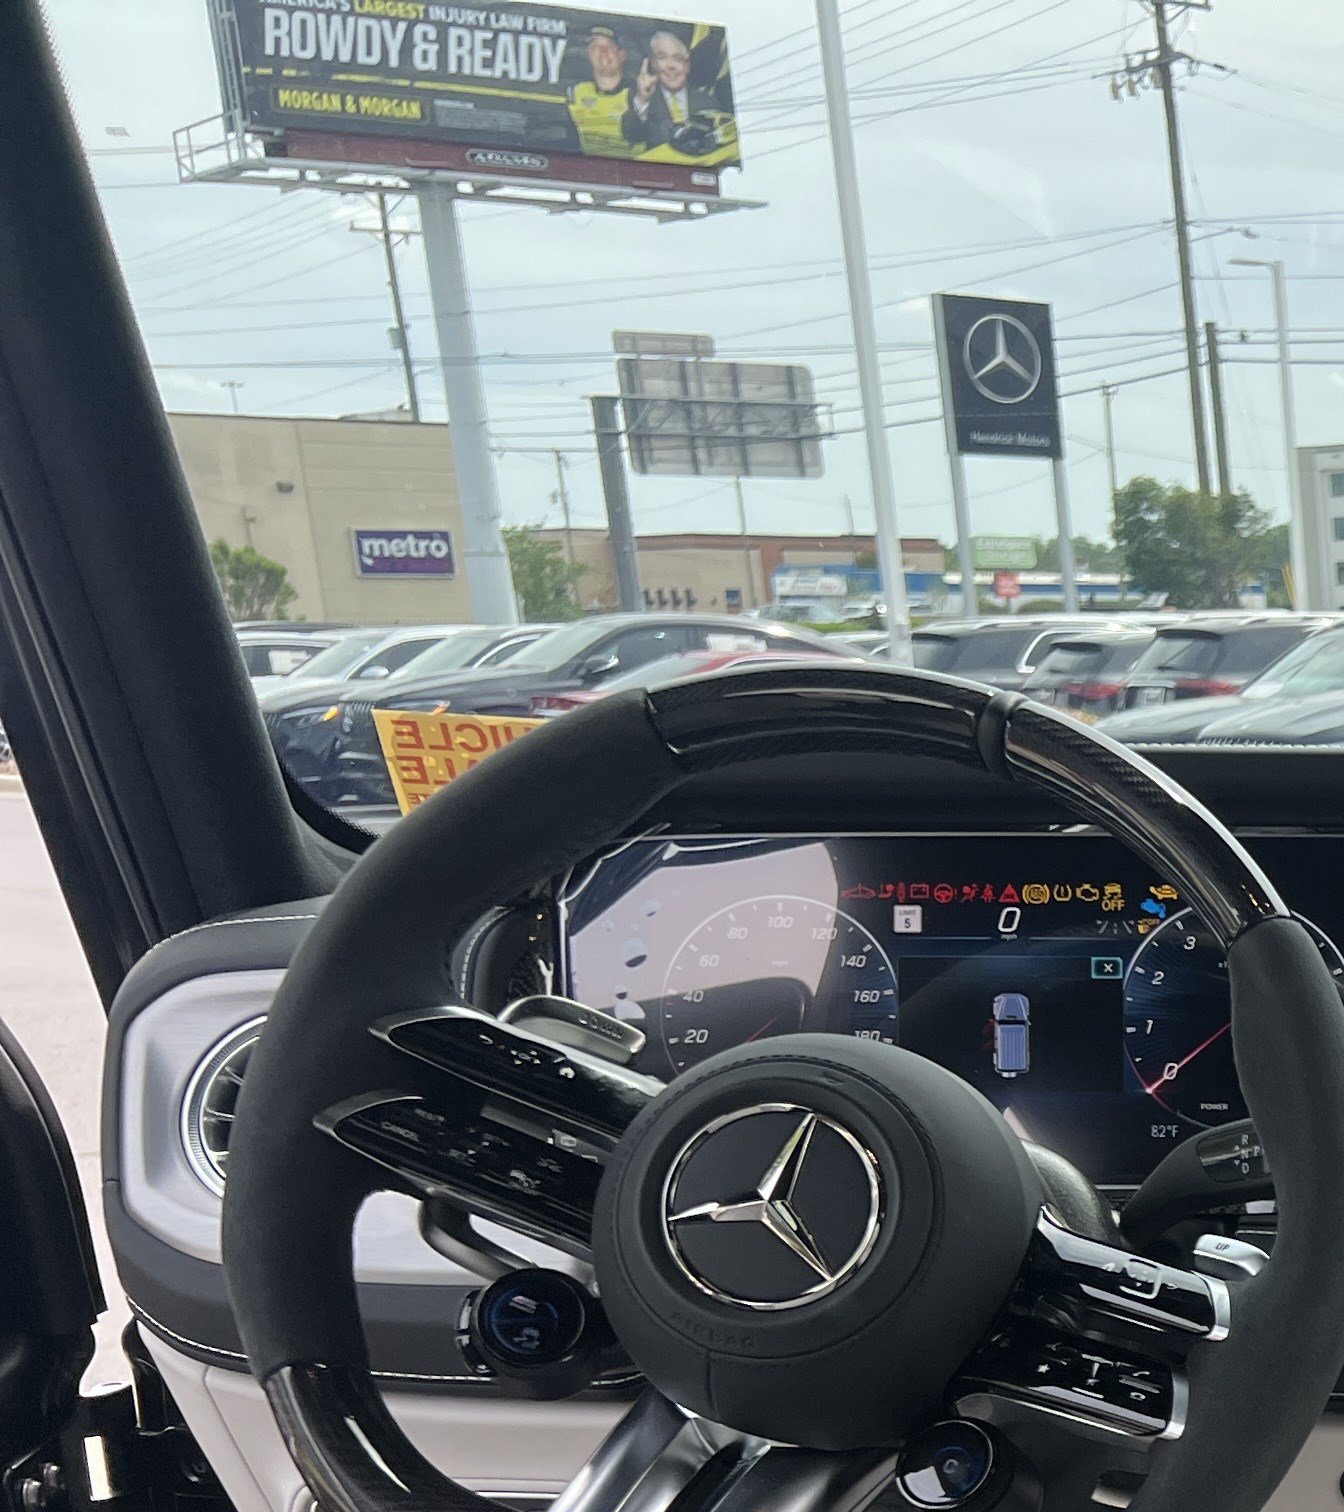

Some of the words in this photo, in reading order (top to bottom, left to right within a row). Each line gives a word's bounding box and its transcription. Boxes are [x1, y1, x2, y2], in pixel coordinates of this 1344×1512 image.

[259, 0, 351, 12] ICA'S
[354, 0, 427, 19] LARGEST
[427, 5, 488, 27] INJURY
[489, 12, 525, 31] LAW
[526, 15, 567, 36] FIRM
[264, 7, 409, 68] ROWDY
[412, 22, 440, 72] &
[447, 25, 568, 84] READY
[278, 88, 342, 112] MORGAN
[345, 93, 357, 113] &
[358, 95, 422, 120] MORGAN
[360, 533, 449, 560] metro
[1101, 900, 1125, 912] OFF
[767, 916, 793, 929] 100
[903, 917, 911, 930] 5
[998, 906, 1022, 934] 0
[727, 928, 748, 940] 80
[811, 927, 838, 940] 120
[1183, 935, 1197, 950] 3
[699, 955, 720, 967] 60
[840, 954, 867, 968] 140
[1151, 970, 1165, 985] 2
[683, 990, 704, 1004] 40
[853, 989, 880, 1004] 160
[1145, 1019, 1154, 1035] 1
[683, 1029, 709, 1045] 20
[1162, 1062, 1178, 1081] 0
[1150, 1125, 1180, 1139] 82°F
[1241, 1134, 1249, 1146] R
